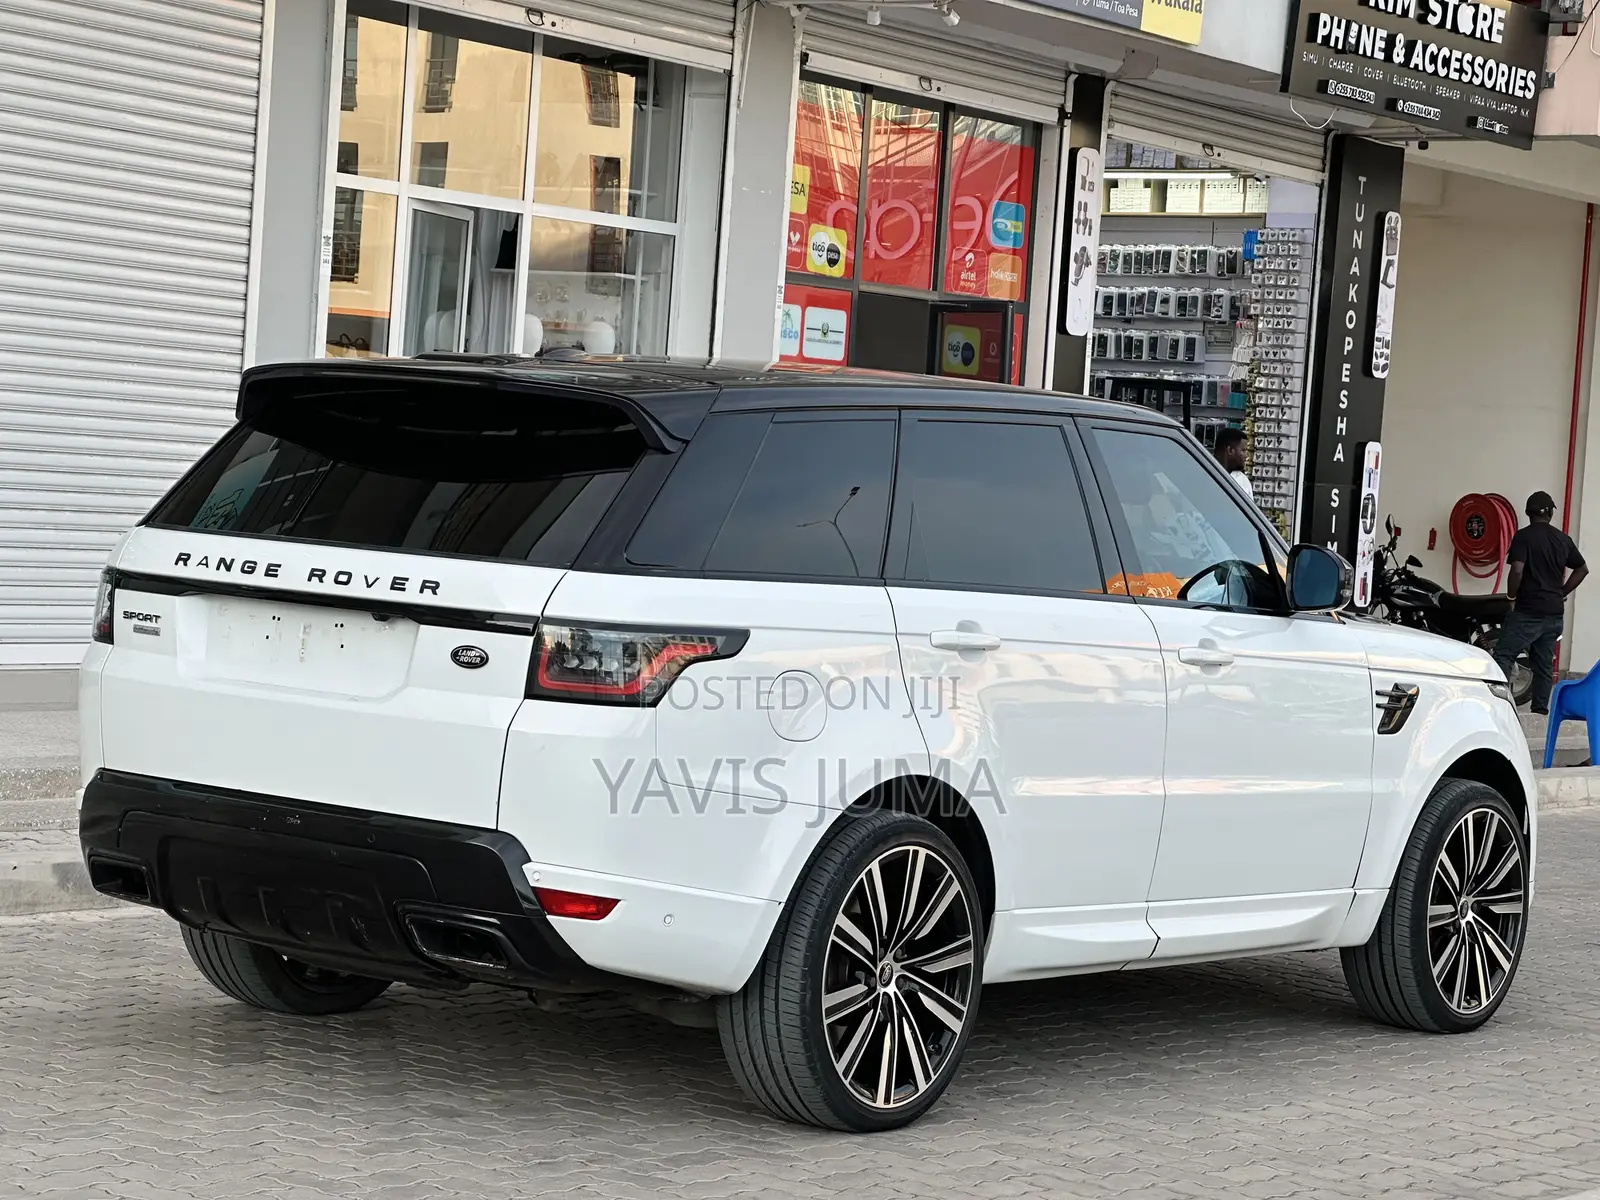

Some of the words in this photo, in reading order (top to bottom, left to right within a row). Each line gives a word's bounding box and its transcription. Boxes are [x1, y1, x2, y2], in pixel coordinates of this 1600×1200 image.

[1115, 1, 1125, 14] Toa
[1126, 4, 1138, 17] Pesa
[1392, 32, 1405, 64] &
[1409, 39, 1537, 100] ACCESSORIES
[1302, 51, 1319, 65] SIMU
[1328, 58, 1354, 73] CHARGE
[1363, 67, 1383, 81] COVER
[1393, 74, 1426, 92] BLUETOOTH
[1435, 85, 1461, 100] SPEAKER
[1497, 101, 1518, 115] LAPTOP
[961, 270, 976, 281] airtel
[1332, 175, 1367, 463] TUNAKOPESHA
[781, 328, 799, 339] SCO
[174, 552, 282, 578] RANGE
[307, 567, 442, 596] ROVER
[122, 610, 162, 624] SPORT
[458, 649, 476, 657] LAND
